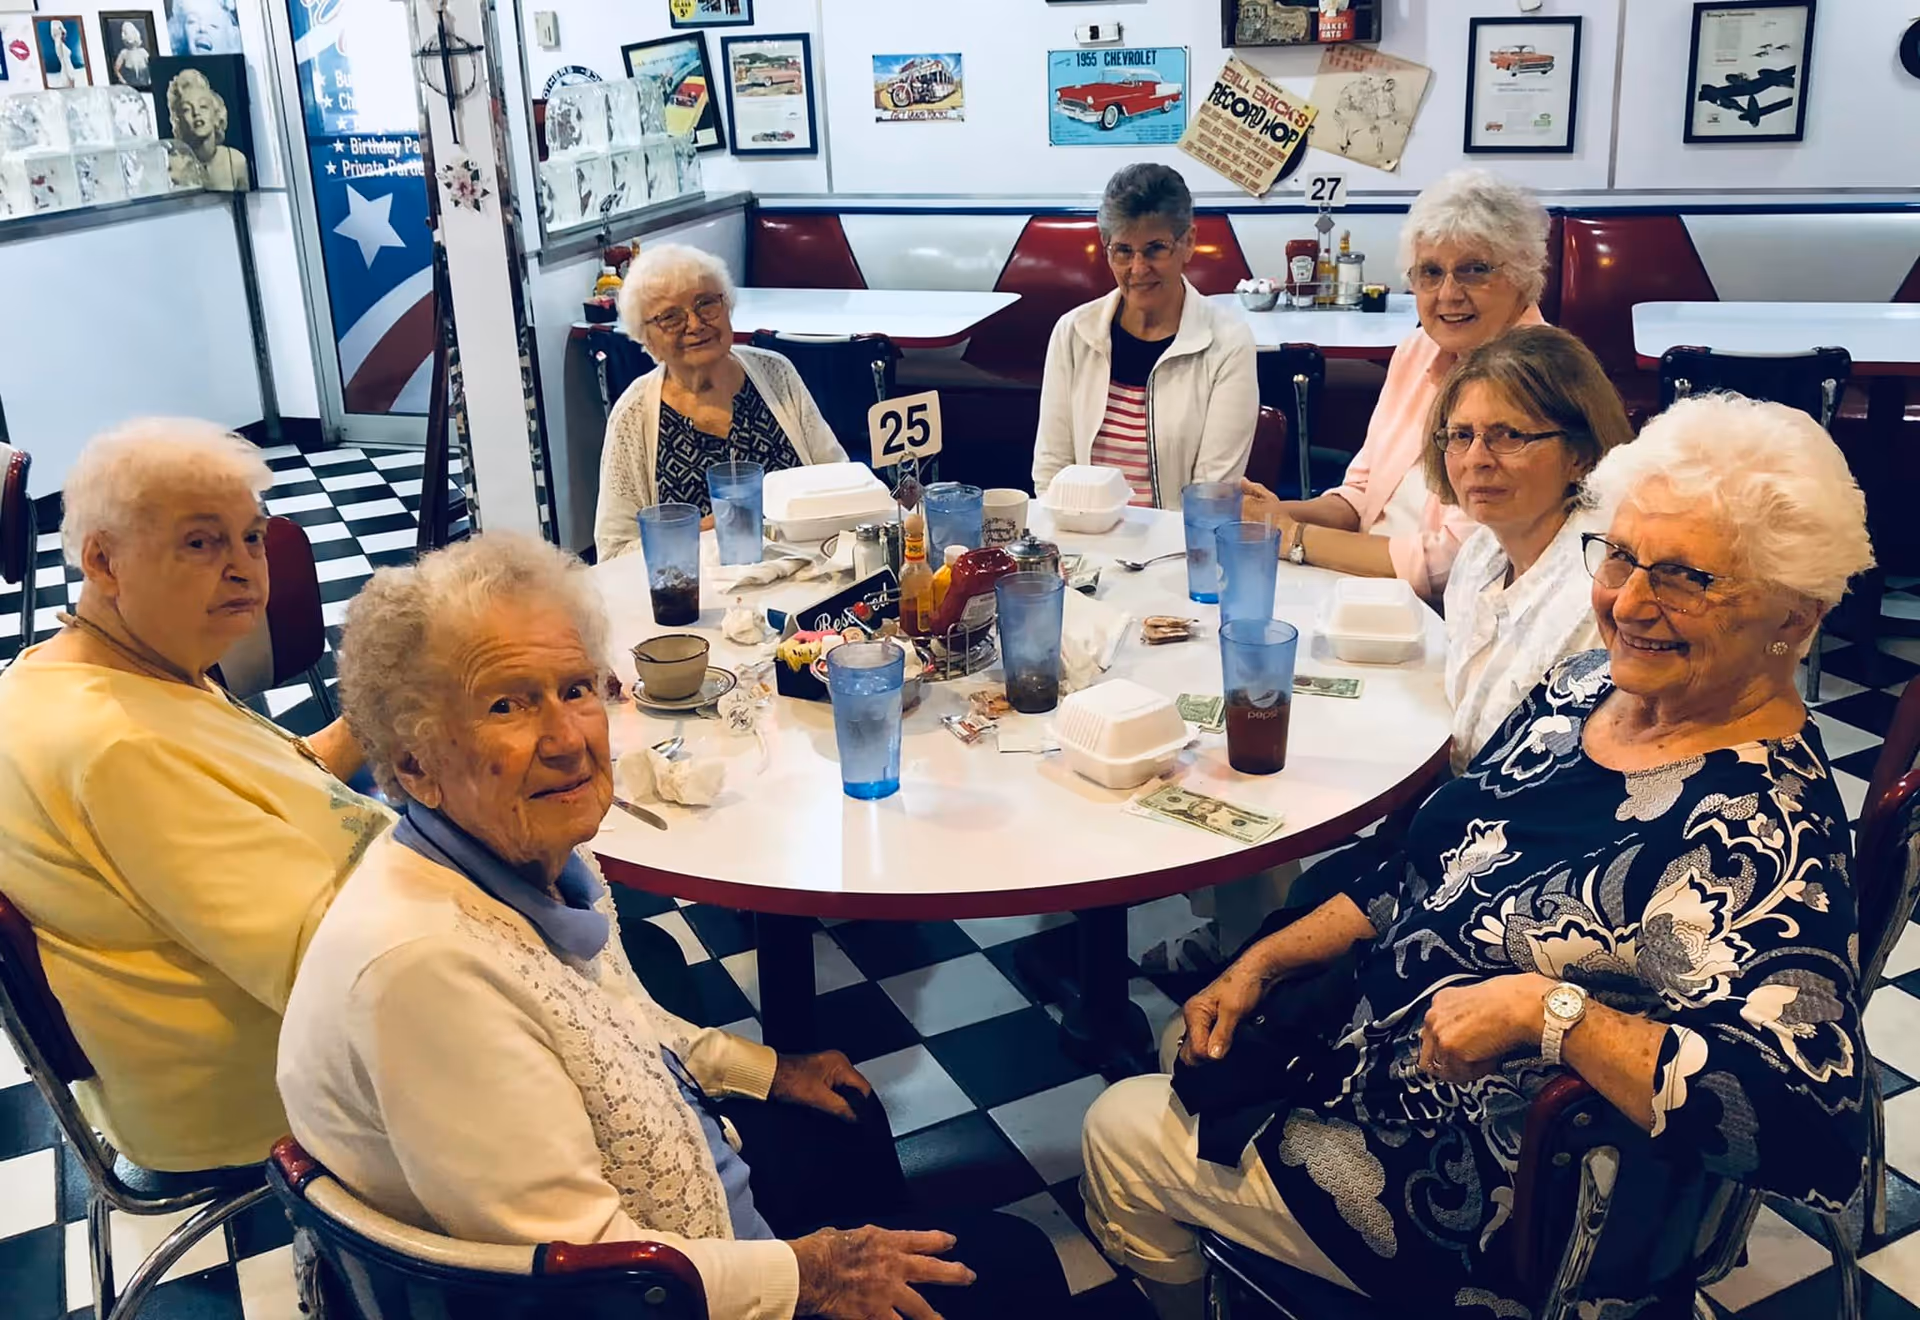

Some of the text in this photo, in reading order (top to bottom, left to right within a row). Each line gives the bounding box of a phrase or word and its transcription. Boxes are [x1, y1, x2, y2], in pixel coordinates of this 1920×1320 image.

[1076, 52, 1097, 67] 1955
[1104, 50, 1157, 66] CHEVROLET
[1221, 65, 1309, 128] BILL BLACK'S
[1207, 81, 1267, 129] RECORD
[1259, 115, 1300, 150] HOP
[350, 136, 401, 158] Birthday
[342, 159, 385, 177] Private
[1311, 177, 1342, 201] 27
[880, 403, 930, 456] 25
[814, 582, 890, 632] Reseed
